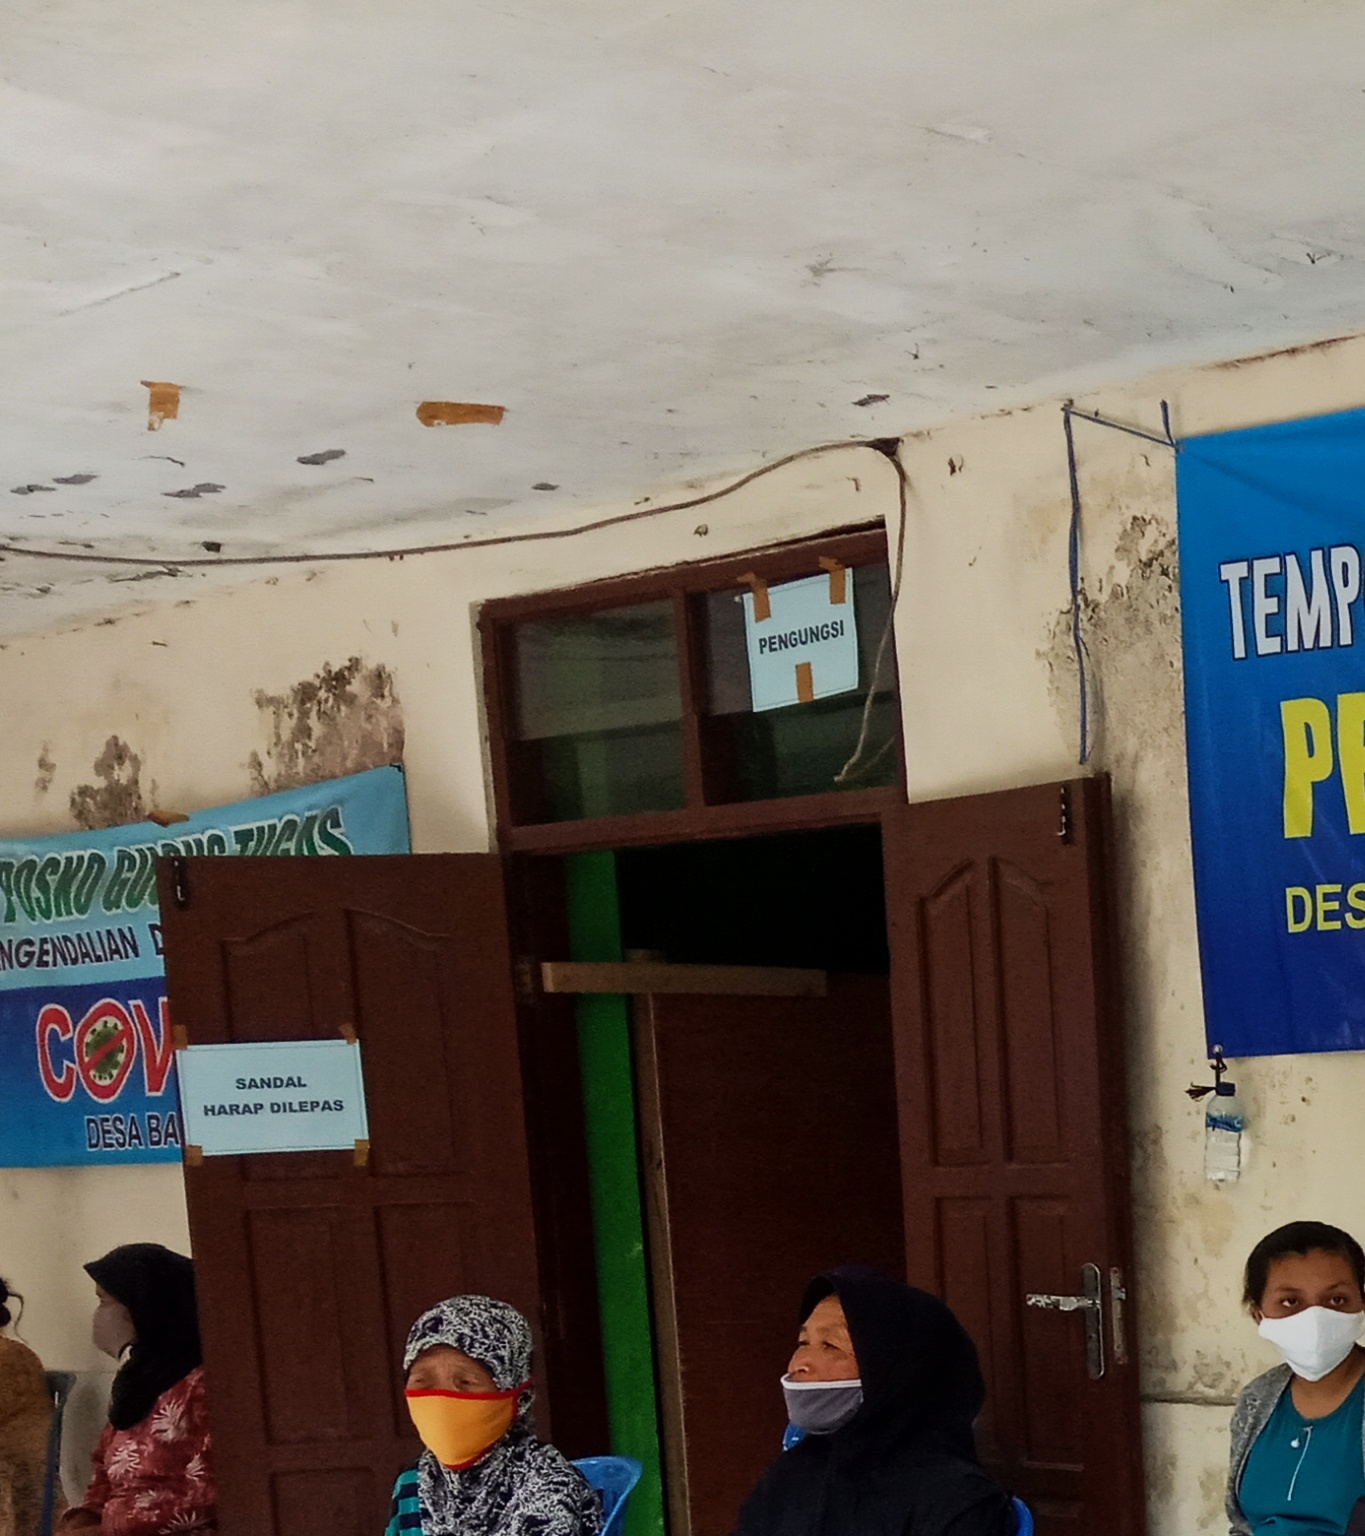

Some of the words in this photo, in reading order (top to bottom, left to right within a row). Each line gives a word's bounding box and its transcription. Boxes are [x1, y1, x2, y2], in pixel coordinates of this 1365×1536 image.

[758, 619, 845, 655] PENGUNGSI
[0, 923, 141, 971] NGENDALIAN
[36, 997, 175, 1104] COV
[234, 1075, 308, 1091] SANDAL
[203, 1102, 265, 1117] HARAP
[269, 1099, 345, 1115] DILEPAS
[84, 1114, 144, 1151] DESA
[146, 1112, 182, 1150] BA
